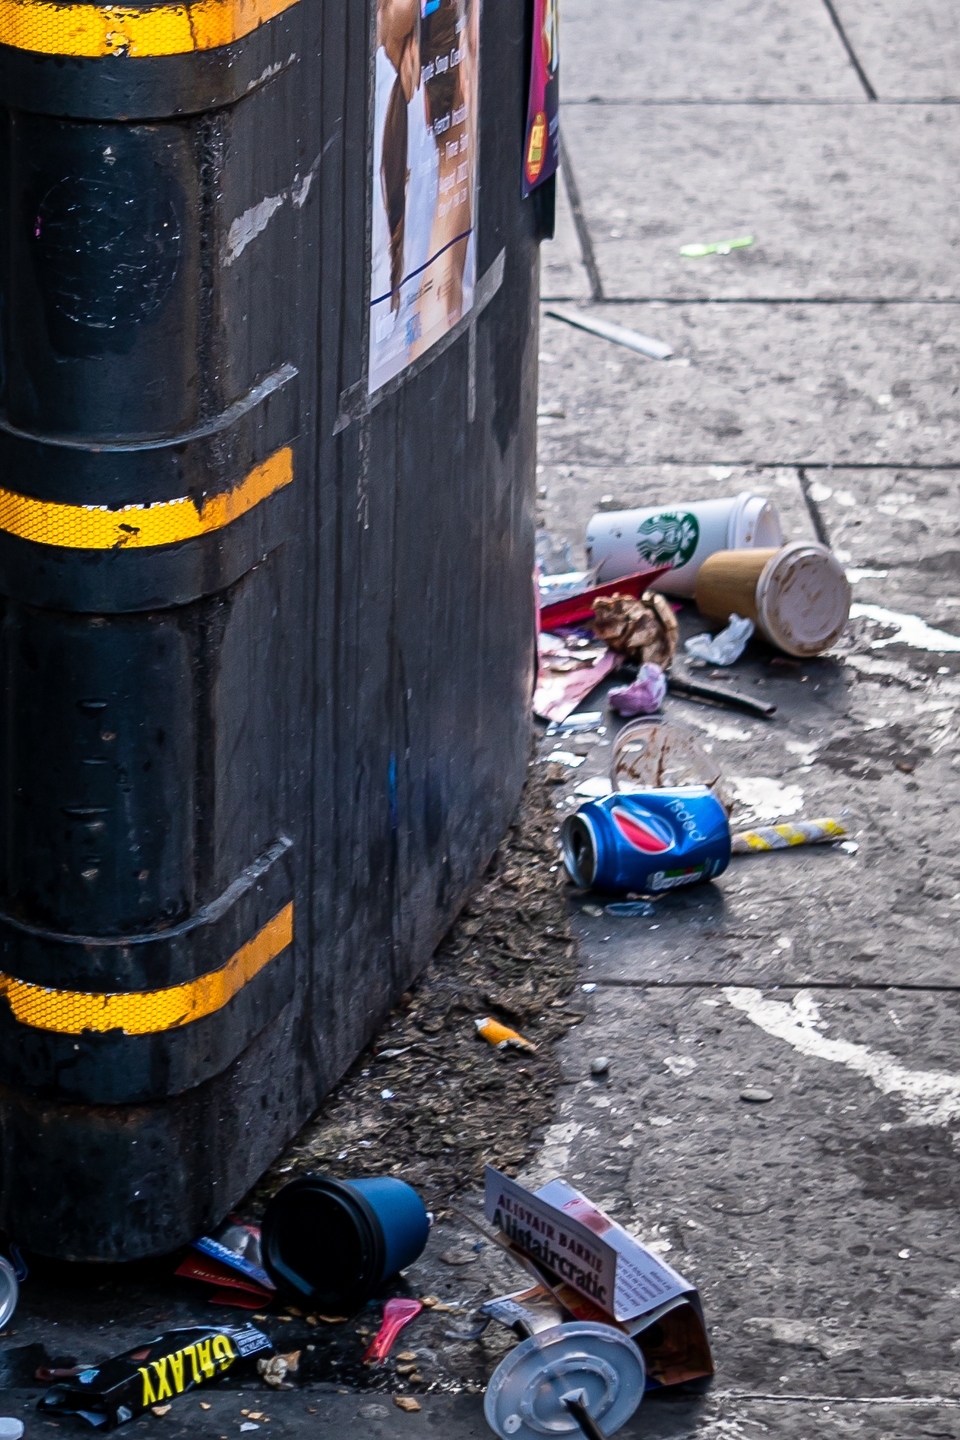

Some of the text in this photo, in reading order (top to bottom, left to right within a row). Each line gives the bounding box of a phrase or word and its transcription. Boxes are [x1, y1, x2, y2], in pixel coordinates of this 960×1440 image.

[663, 798, 706, 842] pepsi
[491, 1208, 607, 1306] Alistaircratic
[497, 1194, 604, 1274] ALISTAIR BARRIE
[137, 1334, 237, 1407] GALAXY
